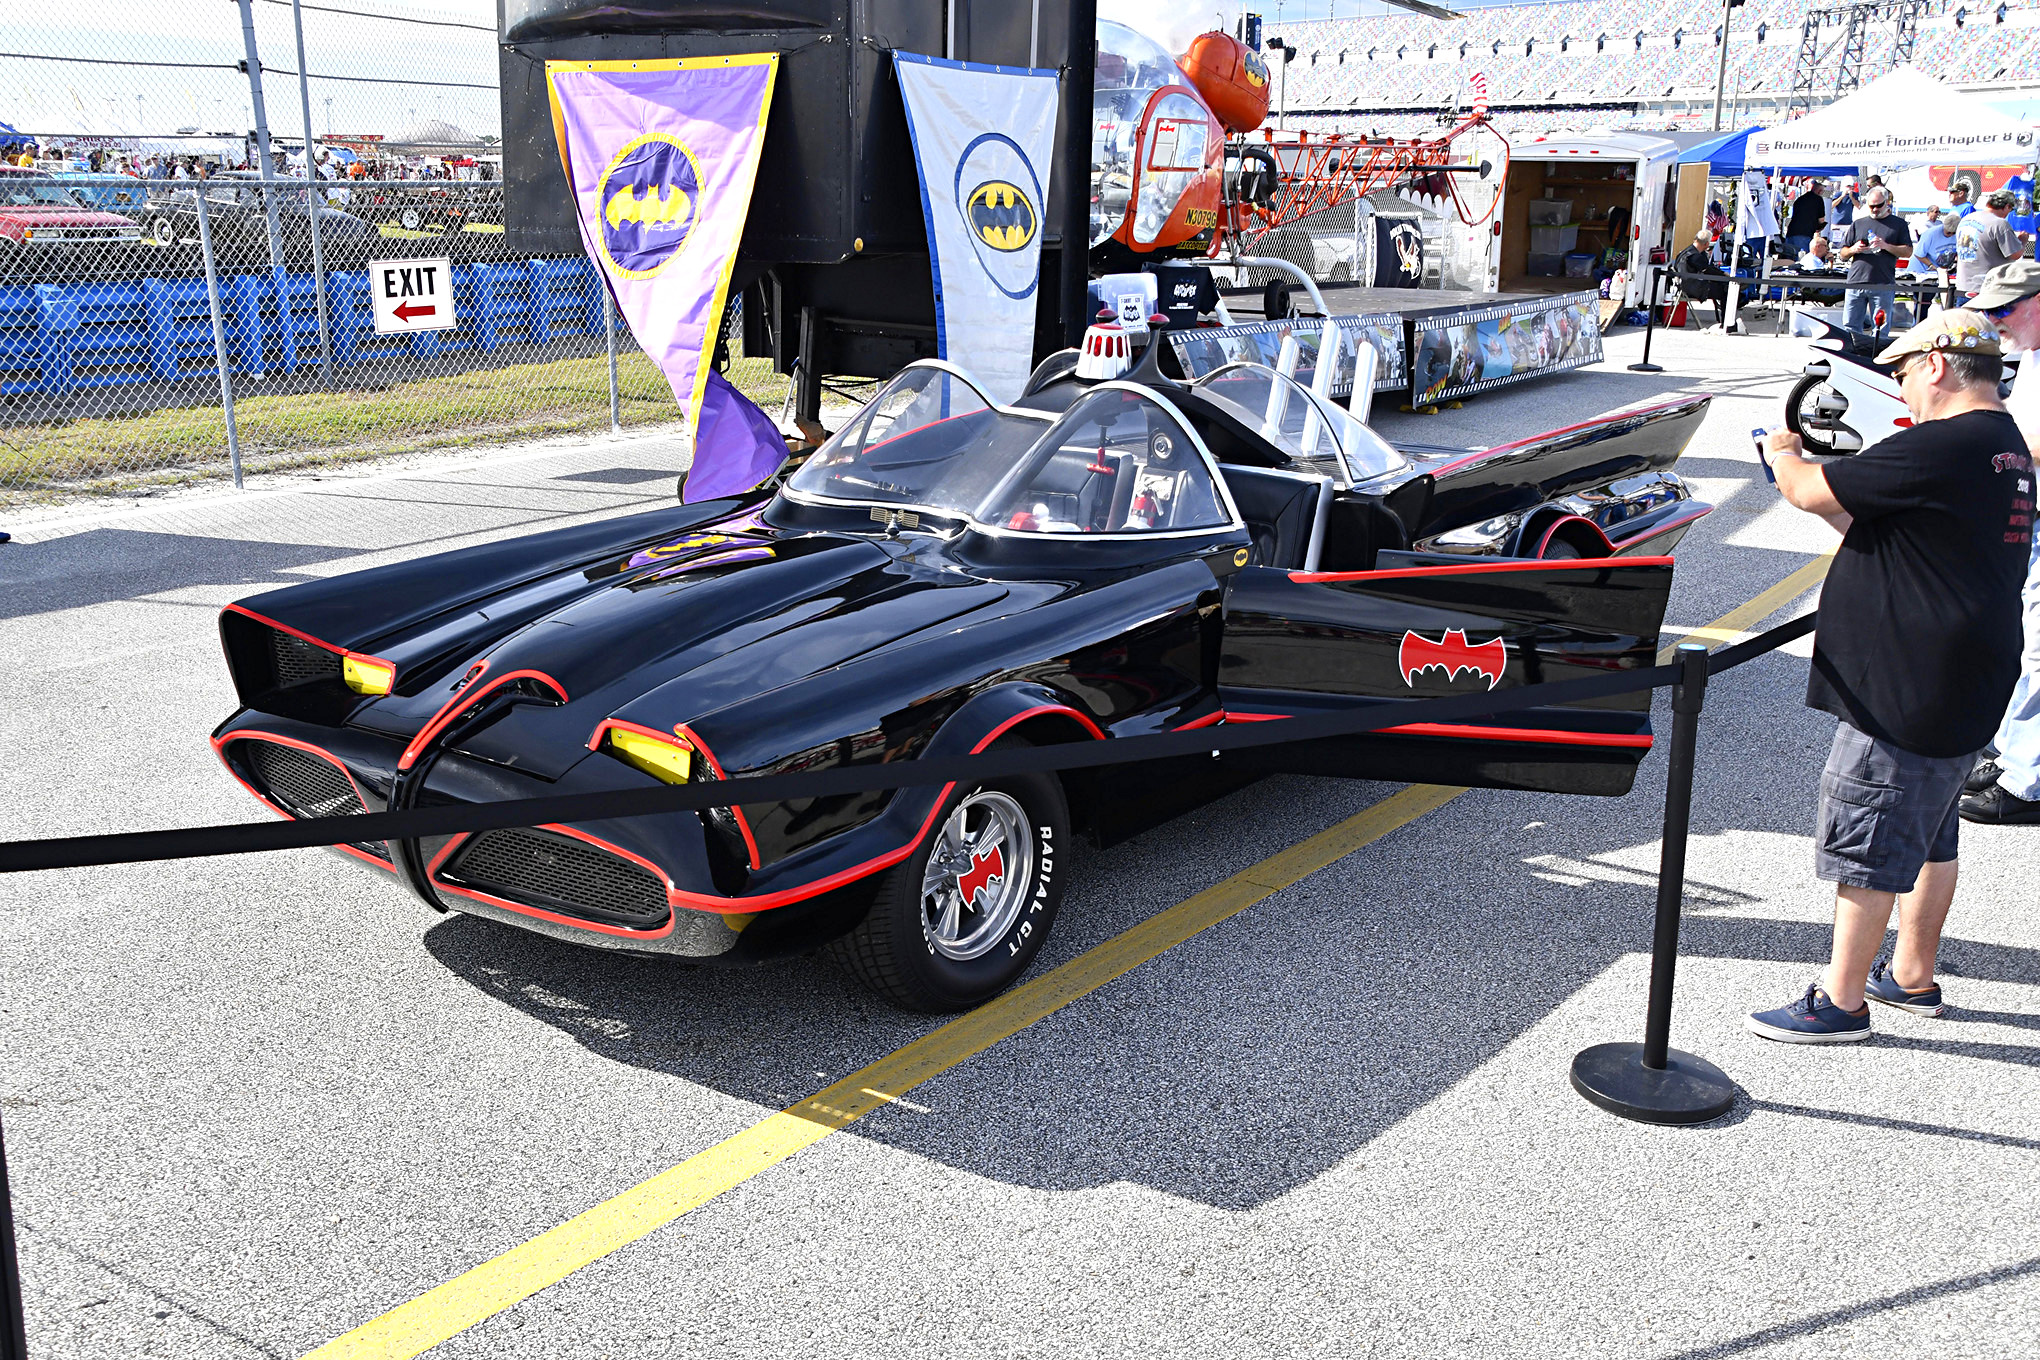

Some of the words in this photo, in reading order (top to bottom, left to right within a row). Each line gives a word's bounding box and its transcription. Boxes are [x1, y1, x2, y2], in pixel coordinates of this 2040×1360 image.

[1774, 140, 1821, 152] Rolling
[1825, 138, 1883, 149] Thunder
[1886, 135, 1936, 147] Florida
[1939, 134, 1999, 146] Chapter
[2002, 132, 2012, 141] 8
[384, 267, 437, 298] EXIT
[1030, 826, 1053, 914] RADIAL
[1008, 920, 1033, 957] G/T
